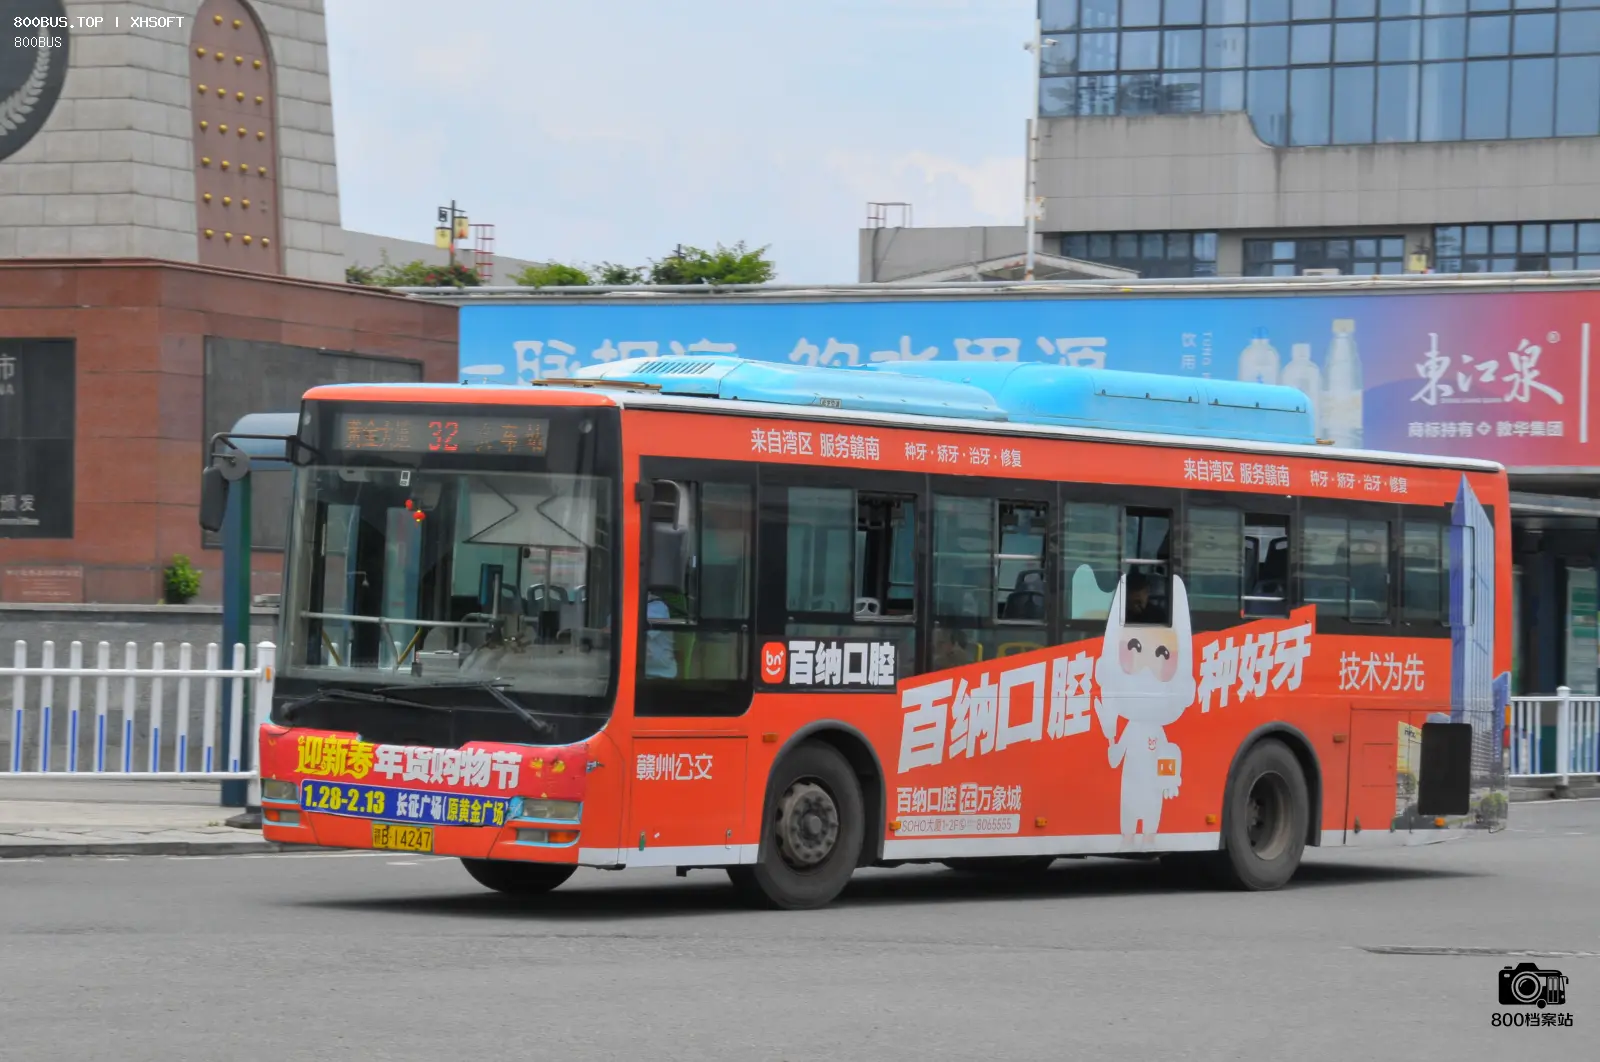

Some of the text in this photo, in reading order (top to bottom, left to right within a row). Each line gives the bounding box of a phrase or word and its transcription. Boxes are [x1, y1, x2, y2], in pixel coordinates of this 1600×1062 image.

[428, 421, 460, 451] 32
[751, 428, 813, 455] 来自湾区
[820, 432, 880, 461] 服务赣南
[1183, 458, 1235, 482] 来自湾区
[1239, 462, 1290, 487] 服务赣南
[788, 640, 896, 686] 百纳口腔
[1338, 651, 1425, 692] 技术为先
[897, 623, 1312, 774] 百纳口腔 种好牙
[636, 752, 714, 781] 赣州公交
[303, 784, 386, 815] 1.28-2.13
